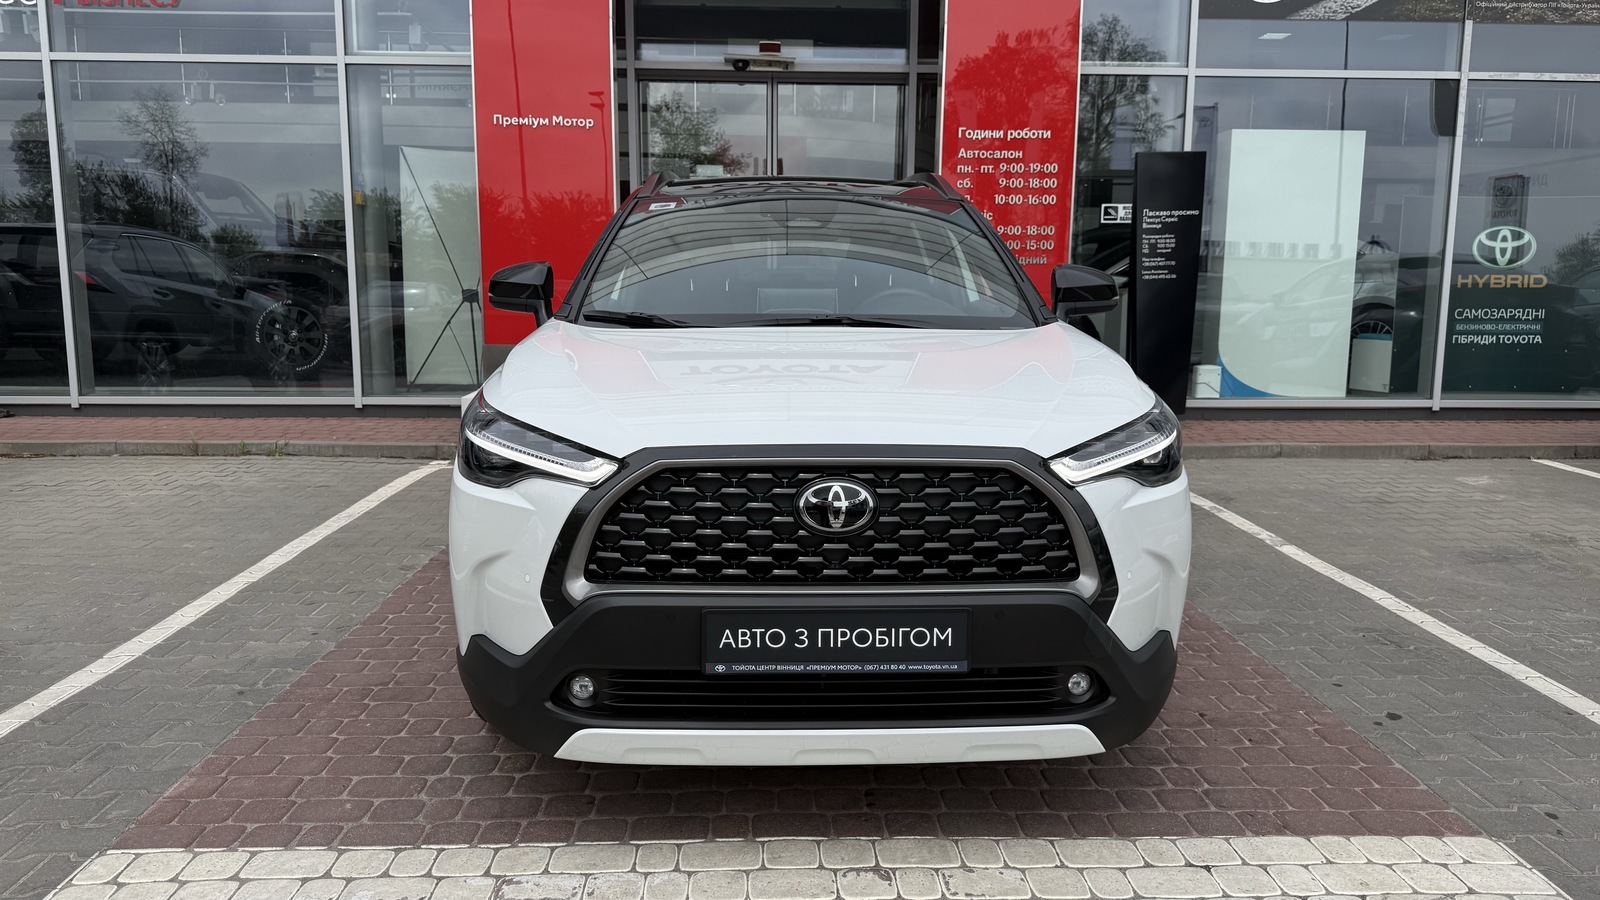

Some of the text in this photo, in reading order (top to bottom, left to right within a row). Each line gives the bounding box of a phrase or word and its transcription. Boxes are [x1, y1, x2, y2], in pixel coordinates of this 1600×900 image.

[493, 114, 594, 129] Преміум Мотор
[958, 127, 1051, 141] Години роботи
[958, 148, 1023, 159] Автосалон
[999, 163, 1058, 174] 9:00-19:00
[957, 178, 1057, 188] сб. 9:00-18:00
[994, 194, 1057, 205] 10:00-16:00
[1171, 209, 1199, 217] просимо
[997, 225, 1055, 236] 9:00-18:00
[1457, 274, 1548, 289] HYBRID
[1454, 308, 1545, 320] САМОЗАРЯДНІ
[1456, 323, 1541, 331] БЕНЗИНОВО-ЕЛЕКТРИЧНІ
[1452, 335, 1542, 345] ГІБРИДИ TOYOTA
[719, 627, 952, 649] АВТО З ПРОБІГОМ
[756, 664, 776, 672] ЦЕНТР
[776, 664, 804, 672] ВІННИЦЯ
[908, 663, 958, 671] www.toyota.vn.ua
